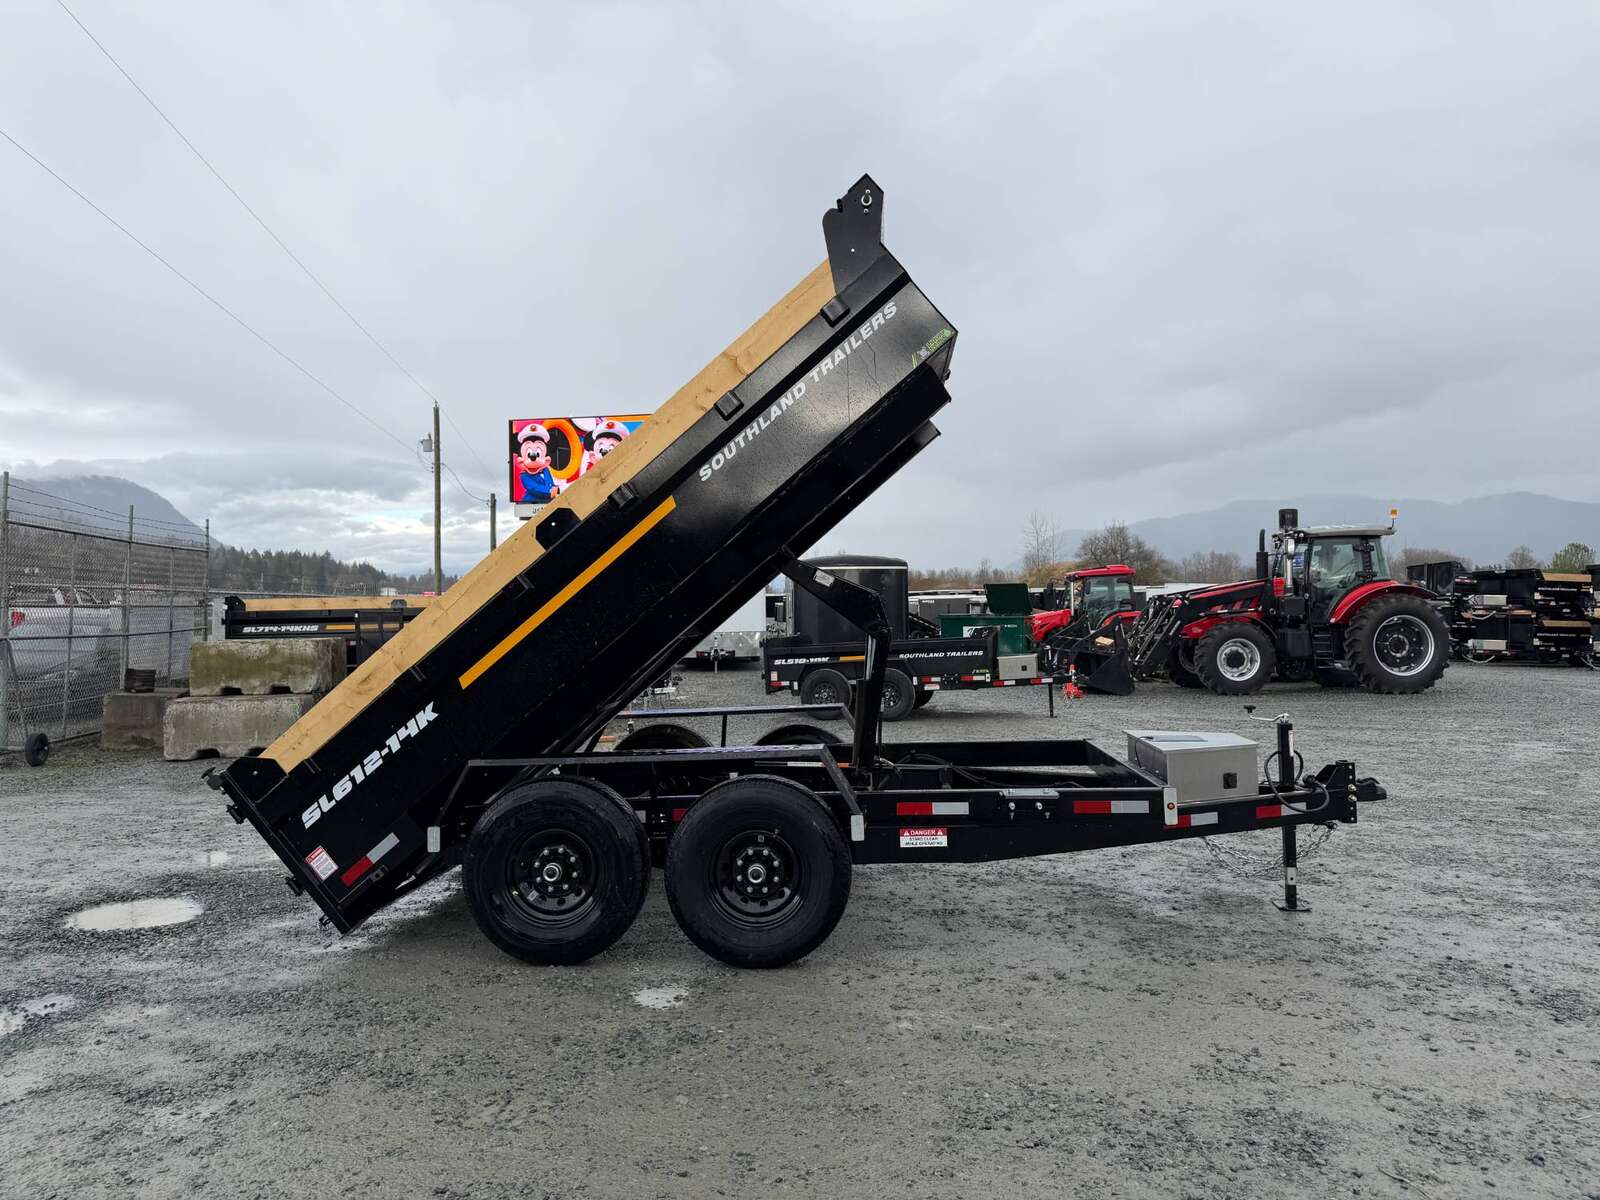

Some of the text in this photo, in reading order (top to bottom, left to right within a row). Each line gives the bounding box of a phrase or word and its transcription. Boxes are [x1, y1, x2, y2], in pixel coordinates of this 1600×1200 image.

[698, 381, 807, 482] SOUTHLAND
[809, 301, 897, 384] TRAILERS
[301, 701, 439, 829] SL612-14K
